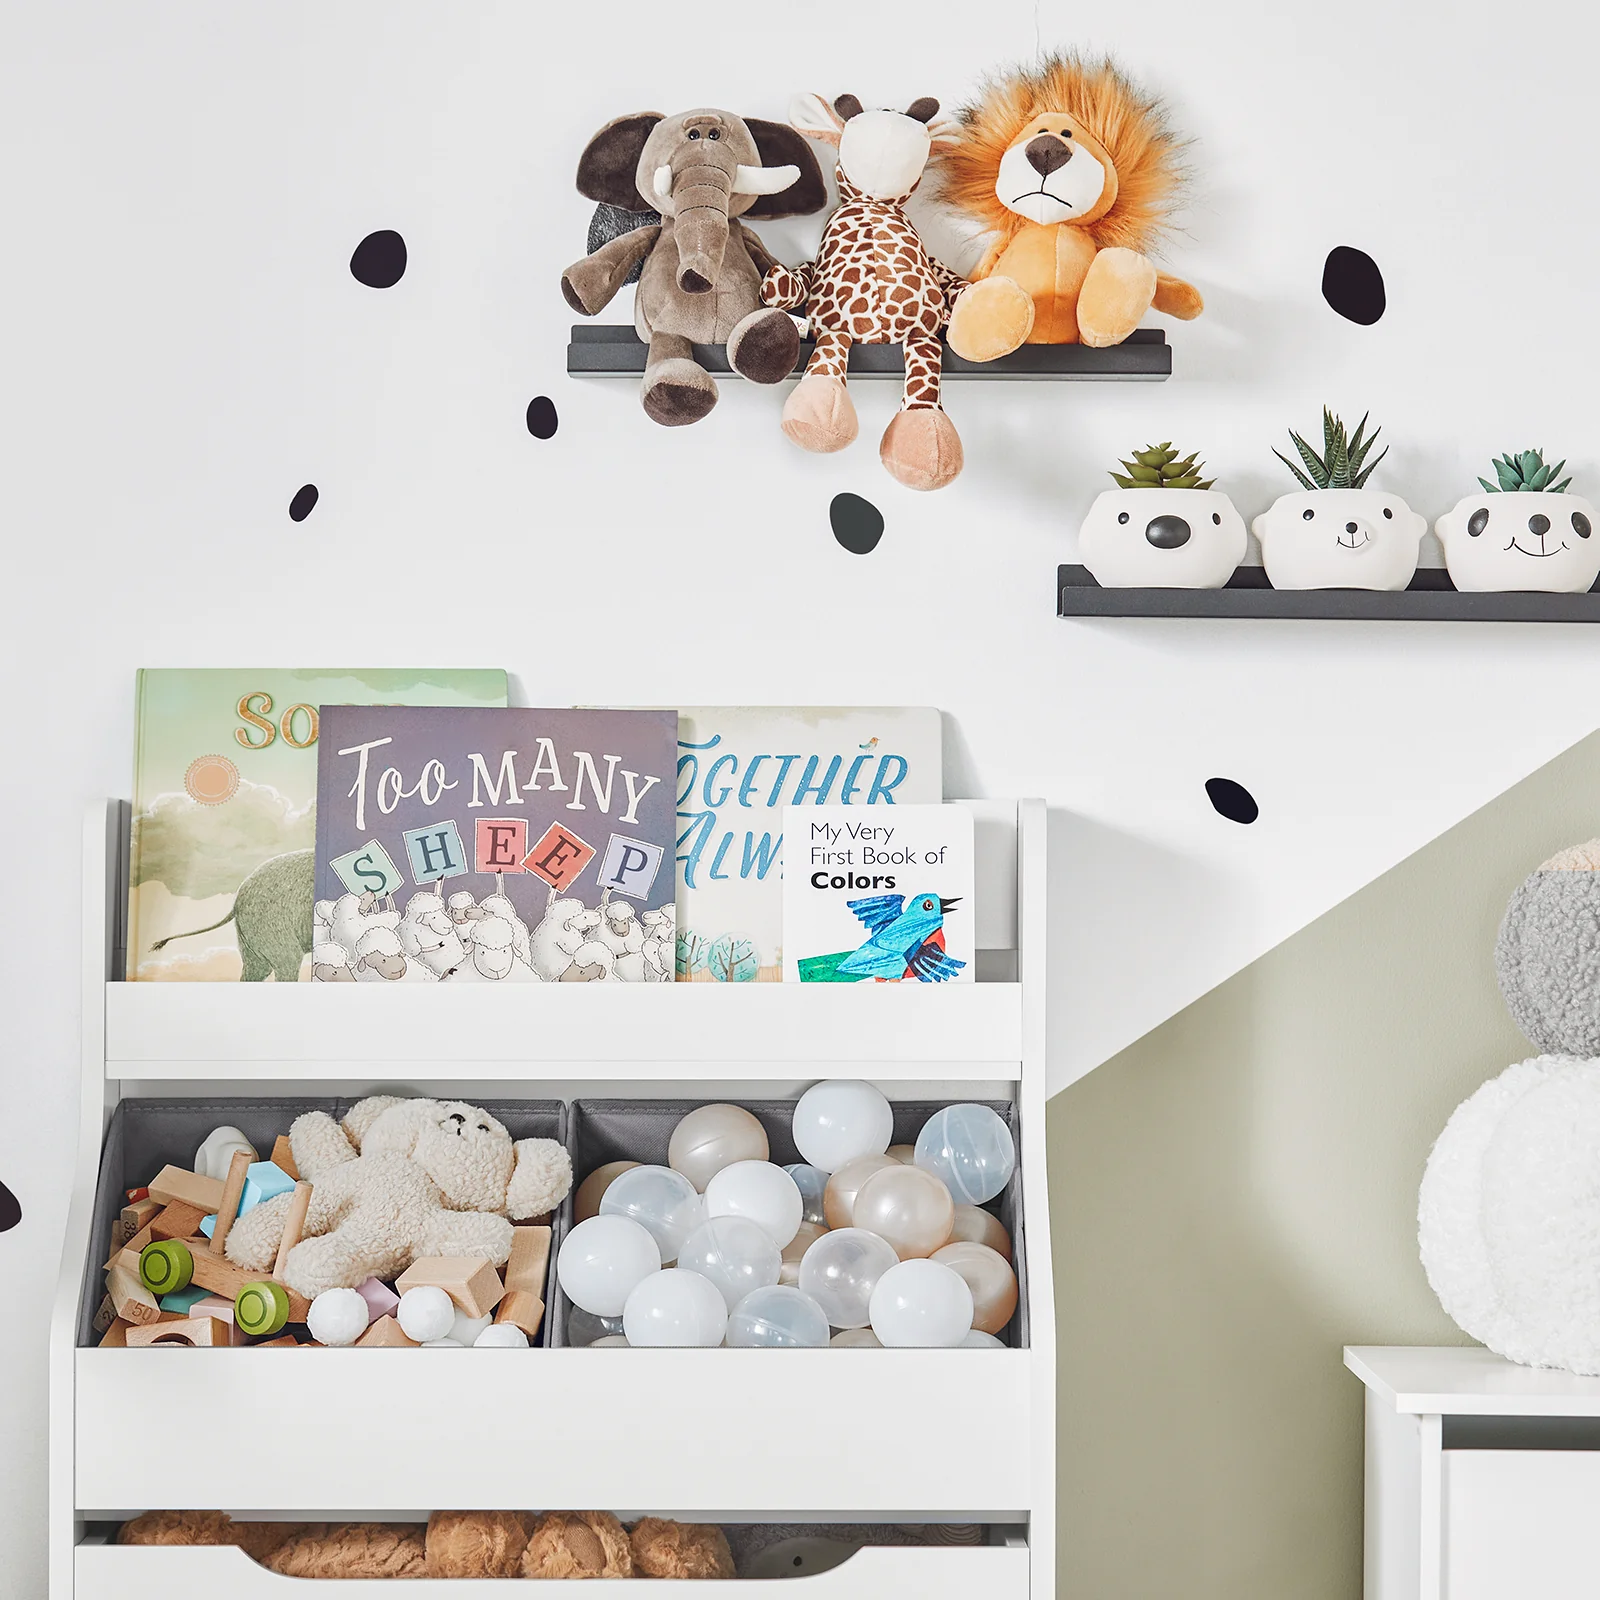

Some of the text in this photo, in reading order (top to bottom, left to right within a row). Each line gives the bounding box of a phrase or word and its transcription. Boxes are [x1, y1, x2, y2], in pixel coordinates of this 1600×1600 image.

[338, 737, 459, 830] Too
[466, 737, 661, 825] MANY
[810, 822, 895, 845] My Very
[352, 825, 649, 895] SHEEP
[676, 810, 784, 889] ALW
[811, 846, 948, 865] First Book of
[810, 871, 896, 890] Colors
[132, 1302, 153, 1321] 50
